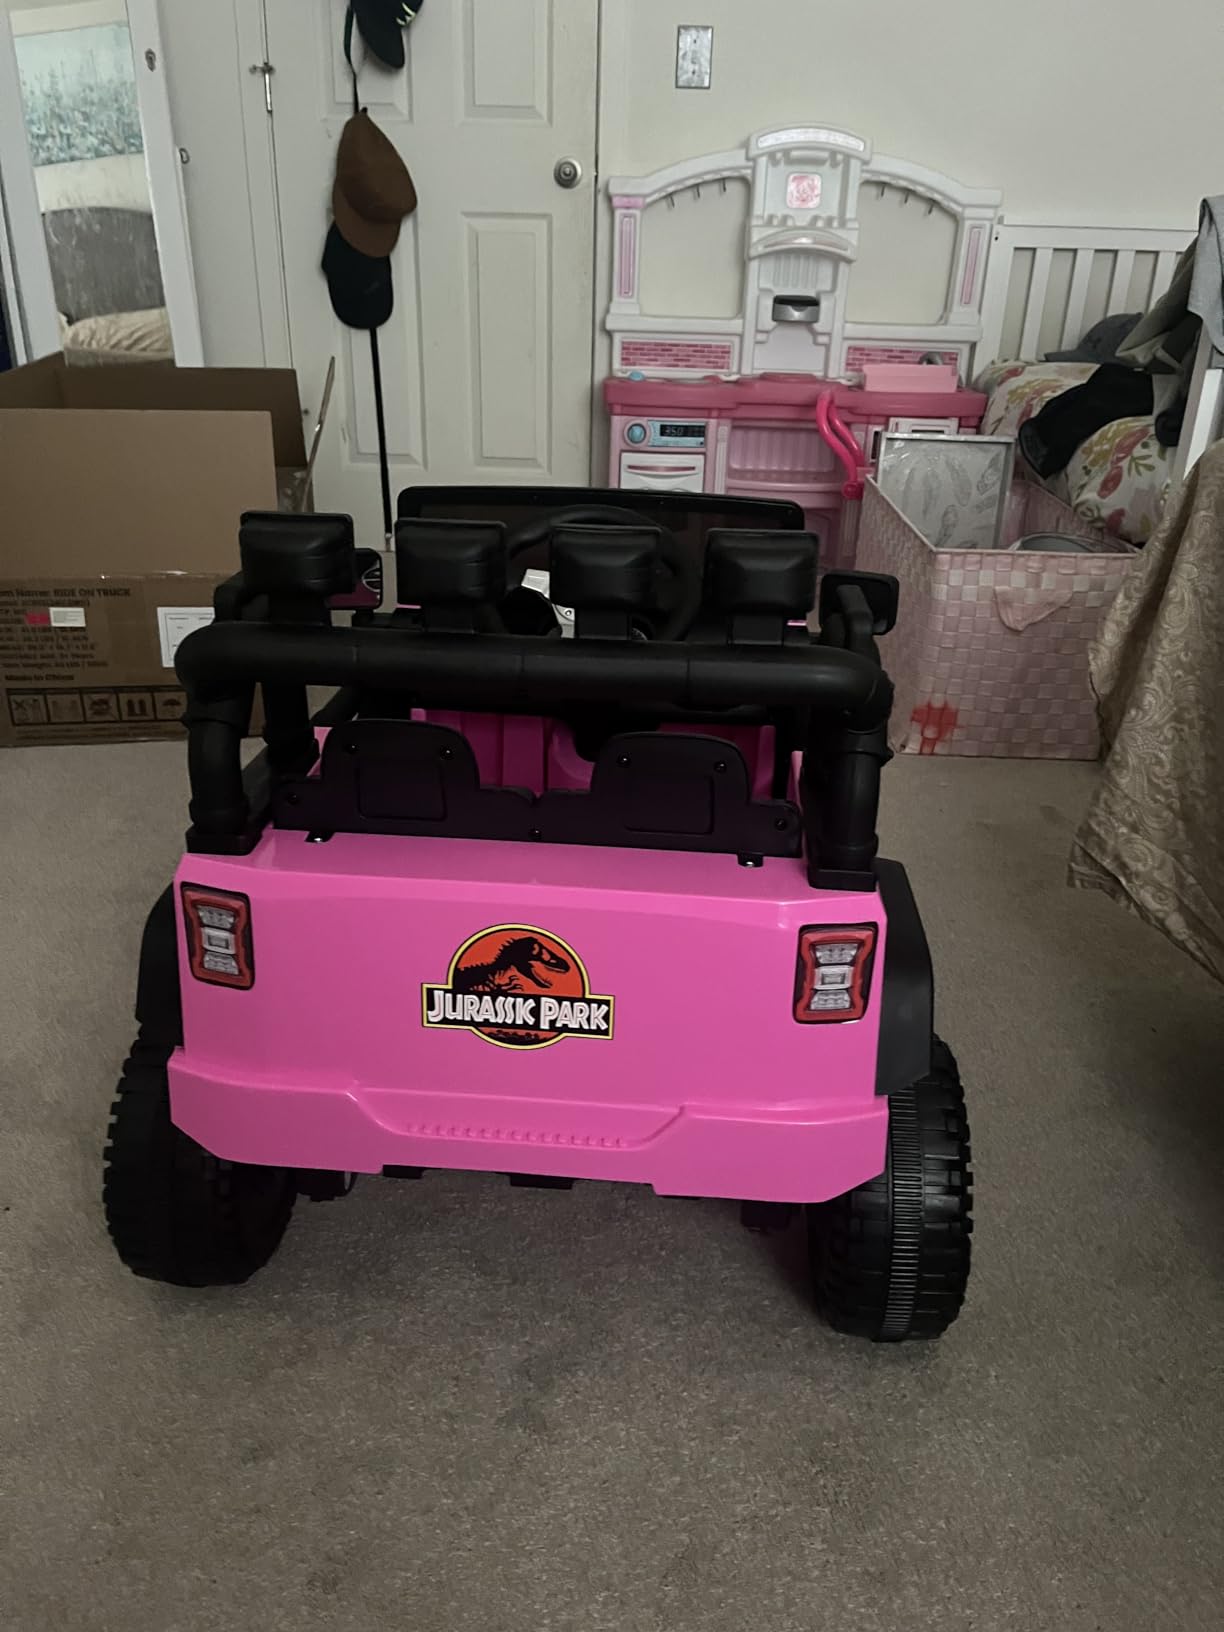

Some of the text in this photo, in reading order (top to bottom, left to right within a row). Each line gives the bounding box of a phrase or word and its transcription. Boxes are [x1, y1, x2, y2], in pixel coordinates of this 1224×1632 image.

[53, 588, 77, 597] RIDE
[78, 588, 95, 597] ON
[95, 588, 131, 597] TRUCK
[427, 990, 609, 1030] JURASSIC PARK
